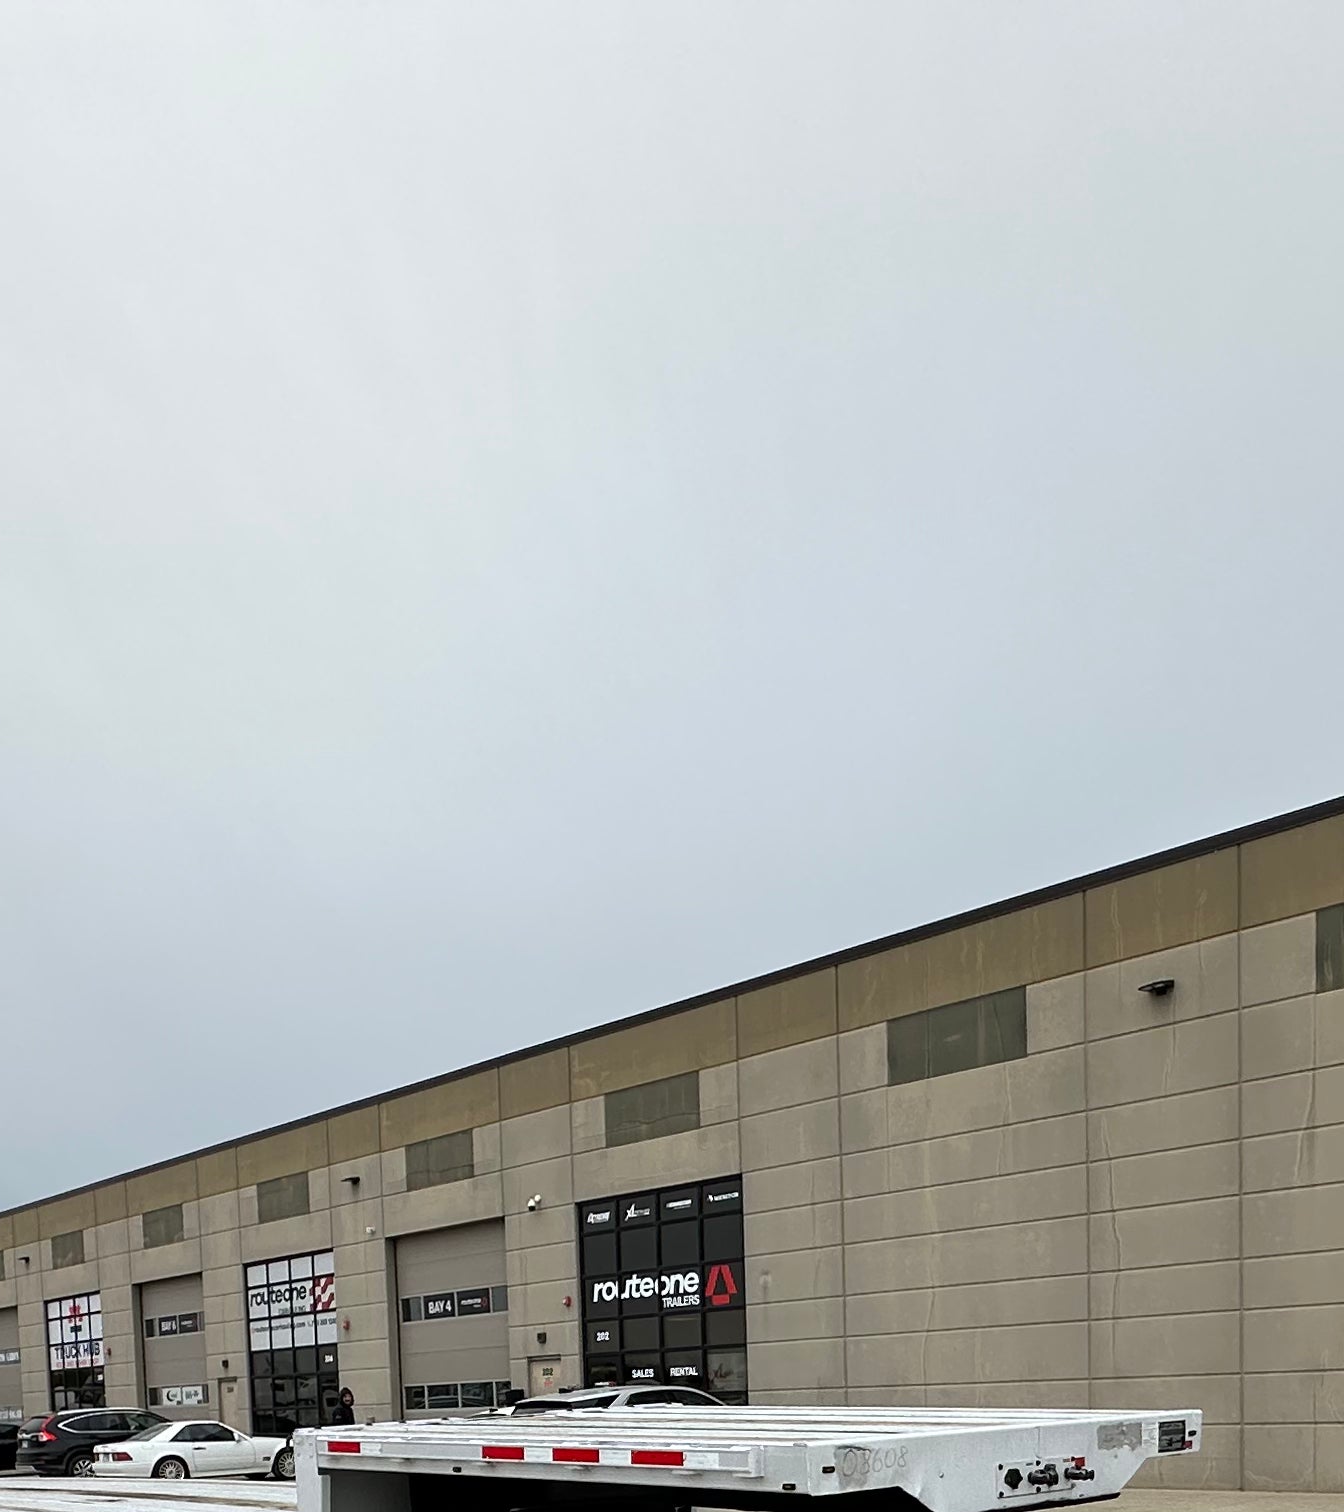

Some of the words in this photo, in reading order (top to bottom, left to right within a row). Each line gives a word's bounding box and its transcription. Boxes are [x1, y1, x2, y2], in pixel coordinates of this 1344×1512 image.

[593, 1271, 700, 1302] routeone
[250, 1285, 307, 1307] routeone
[662, 1294, 700, 1308] TRAILERS
[428, 1300, 444, 1314] BAY
[445, 1300, 452, 1312] 4
[631, 1368, 654, 1378] SALES
[669, 1366, 698, 1377] RENTAL
